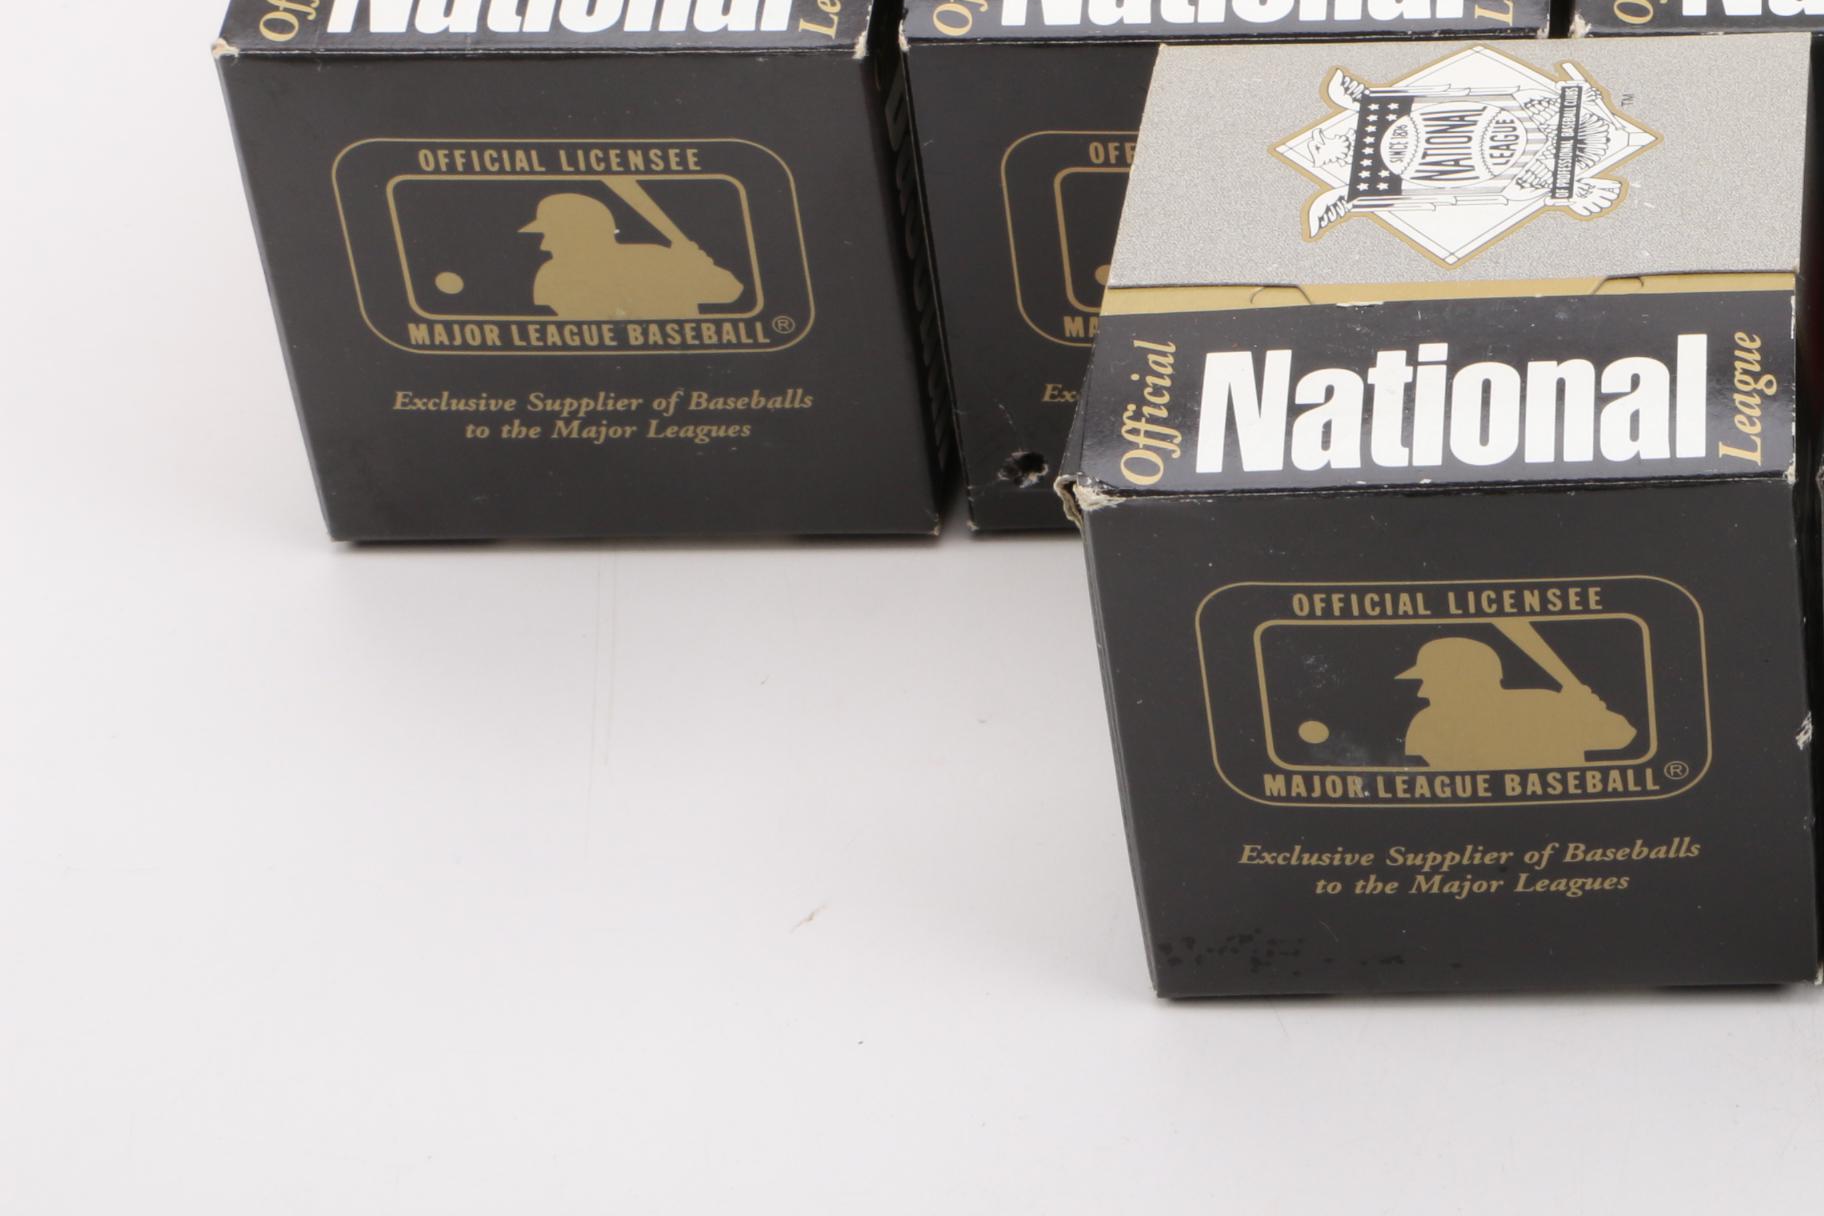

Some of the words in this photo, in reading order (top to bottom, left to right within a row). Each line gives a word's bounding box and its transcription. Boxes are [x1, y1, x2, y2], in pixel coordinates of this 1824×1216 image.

[1564, 88, 1578, 106] CLUBS
[1561, 107, 1576, 137] BASEBALL
[1389, 141, 1408, 163] SINCE
[1410, 106, 1487, 181] NATIONAL
[1489, 119, 1519, 165] LEAGUE
[418, 149, 545, 172] OFFICIAL
[559, 148, 702, 172] LICENSEE
[1556, 140, 1573, 187] PROFESSIONAL
[1555, 189, 1568, 197] OF
[408, 323, 501, 346] MAJOR
[512, 323, 617, 346] LEAGUE
[628, 322, 771, 344] BASEBALL
[394, 390, 516, 412] Exclusive
[528, 391, 642, 416] Supplier
[652, 388, 684, 415] of
[689, 389, 814, 410] Baseballs
[1120, 339, 1185, 485] Official
[1195, 334, 1707, 474] National
[1719, 331, 1778, 467] League
[465, 421, 490, 439] to
[501, 419, 541, 439] the
[551, 419, 636, 444] Major
[646, 419, 752, 443] Leagues
[1292, 592, 1430, 618] OFFICIAL
[1448, 587, 1603, 614] LICENSEE
[1264, 774, 1363, 798] MAJOR
[1377, 774, 1492, 799] LEAGUE
[1505, 769, 1660, 797] BASEBALL
[1240, 843, 1374, 866] Exclusive
[1386, 844, 1514, 871] Supplier
[1523, 842, 1559, 869] of
[1564, 837, 1700, 863] Baseballs
[1315, 876, 1342, 896] to
[1353, 874, 1397, 896] the
[1409, 873, 1504, 899] Major
[1515, 872, 1630, 898] Leagues
